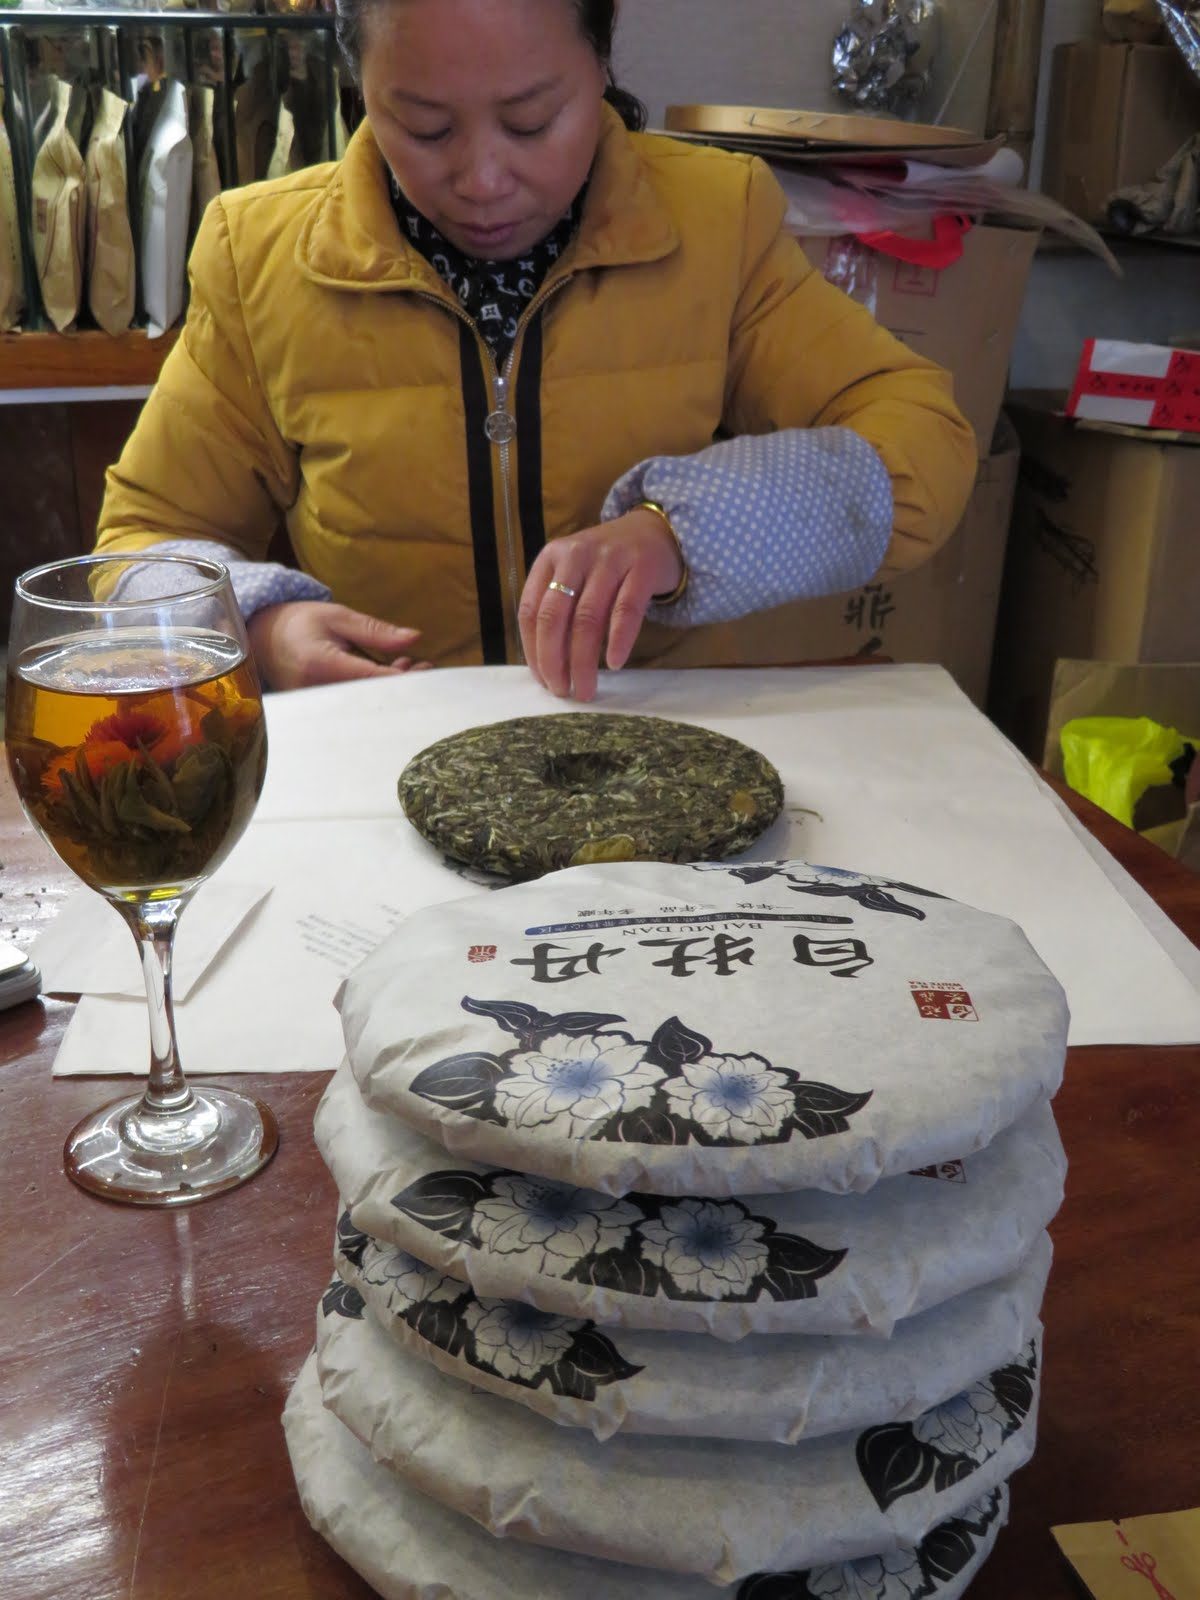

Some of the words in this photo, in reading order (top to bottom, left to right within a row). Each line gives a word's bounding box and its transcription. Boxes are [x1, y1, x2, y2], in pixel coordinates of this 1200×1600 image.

[680, 924, 715, 933] MU
[723, 921, 764, 930] BAI
[622, 926, 673, 936] DAN
[509, 933, 875, 983] 白牡丹
